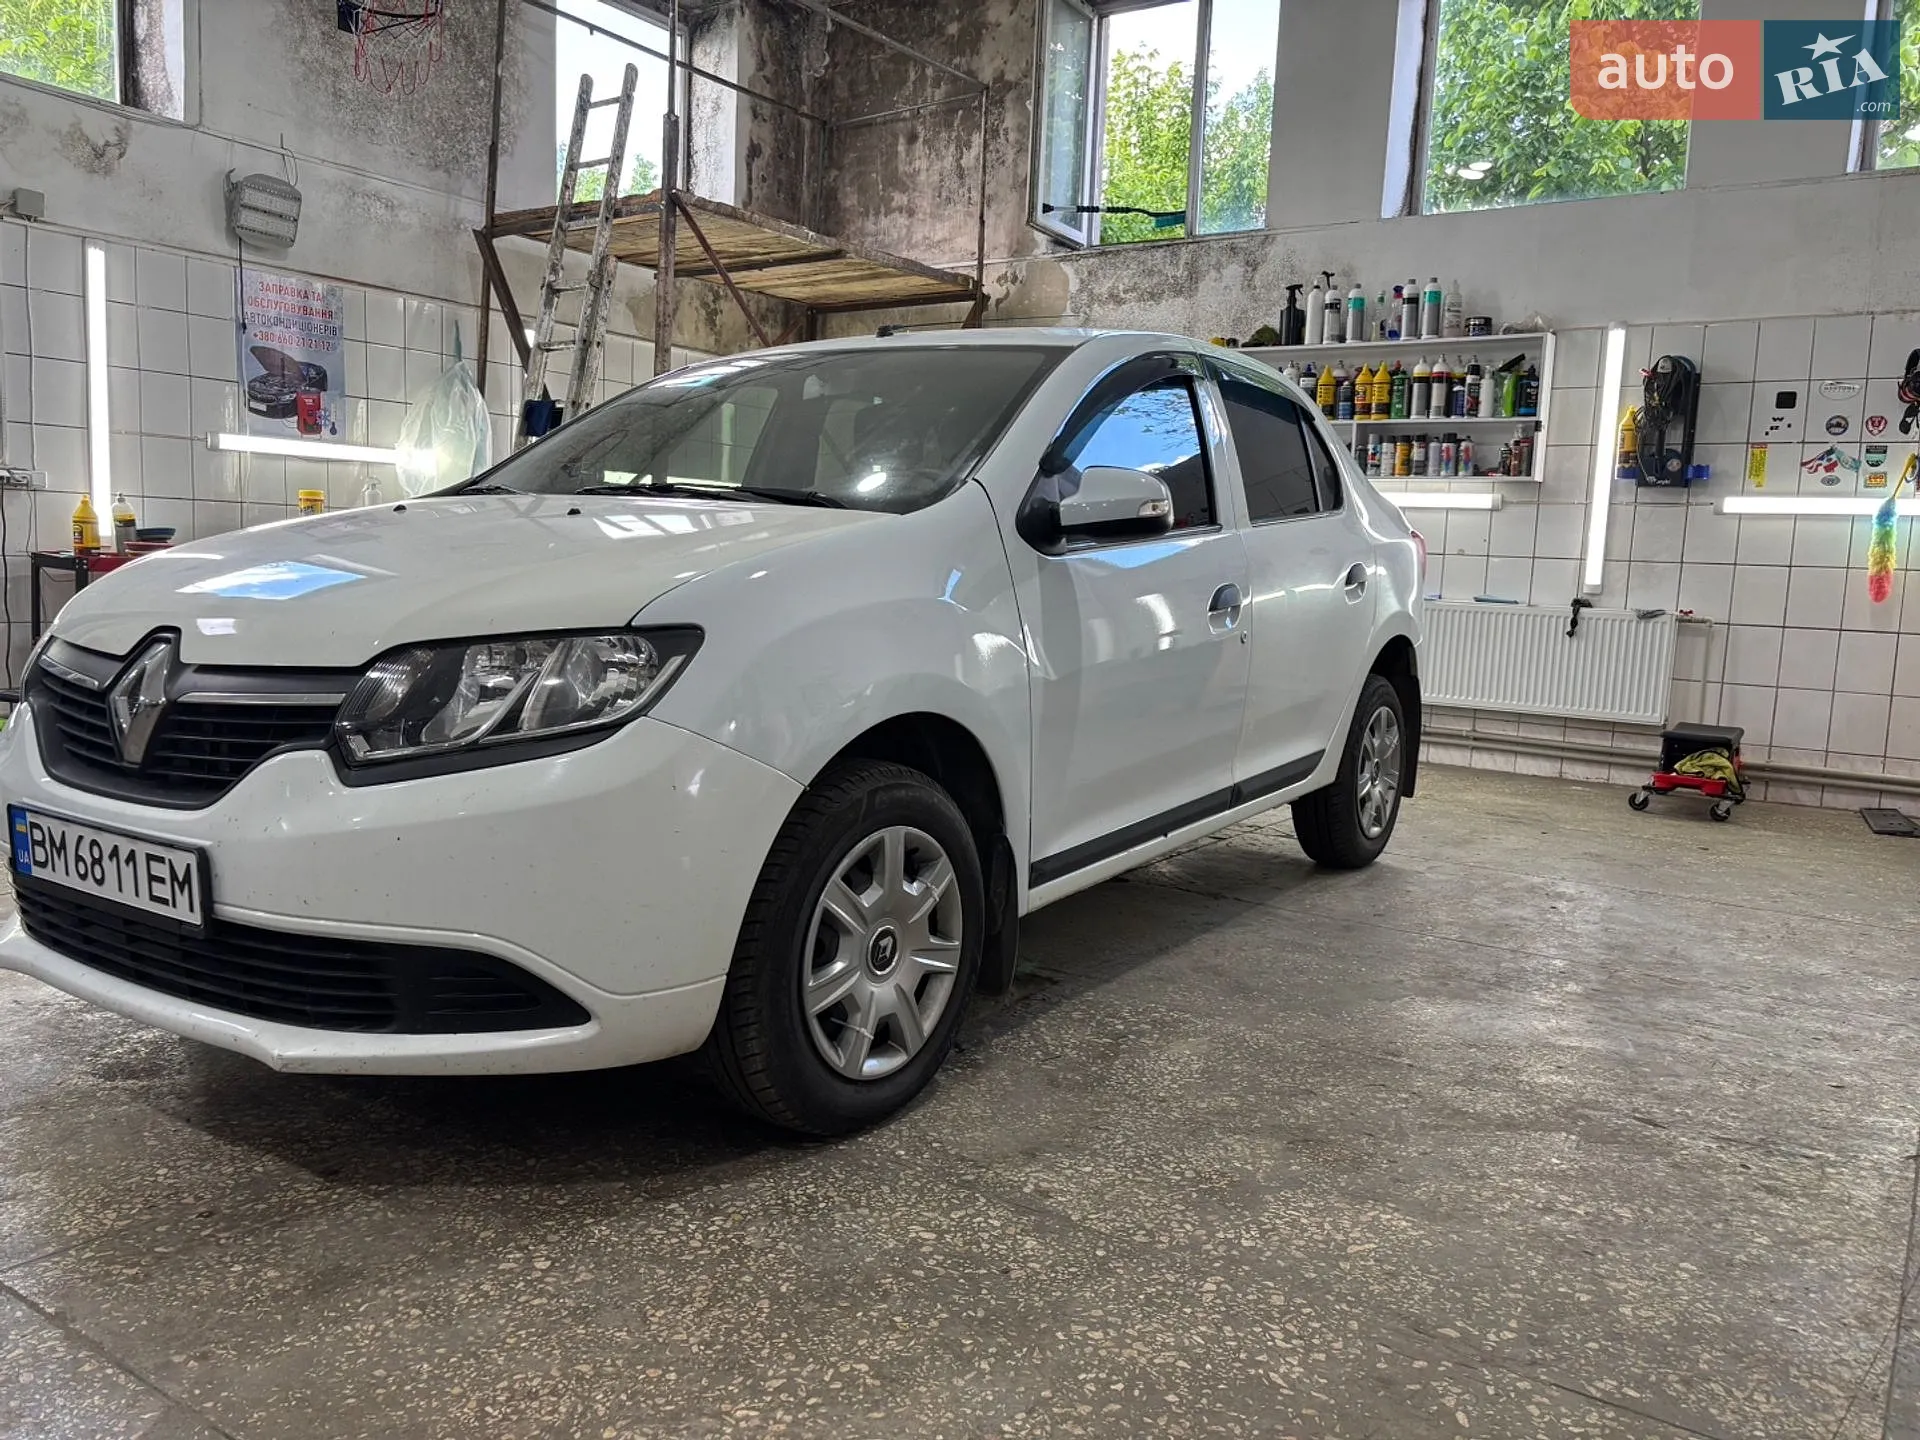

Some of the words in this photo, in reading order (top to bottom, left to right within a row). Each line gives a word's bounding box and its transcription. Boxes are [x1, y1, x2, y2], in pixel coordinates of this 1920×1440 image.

[258, 281, 309, 300] ЗАПРАВКА
[310, 290, 322, 303] ТА
[247, 296, 334, 321] ОБСЛУГОВУВАННЯ
[253, 330, 274, 343] +380
[18, 849, 31, 865] UA
